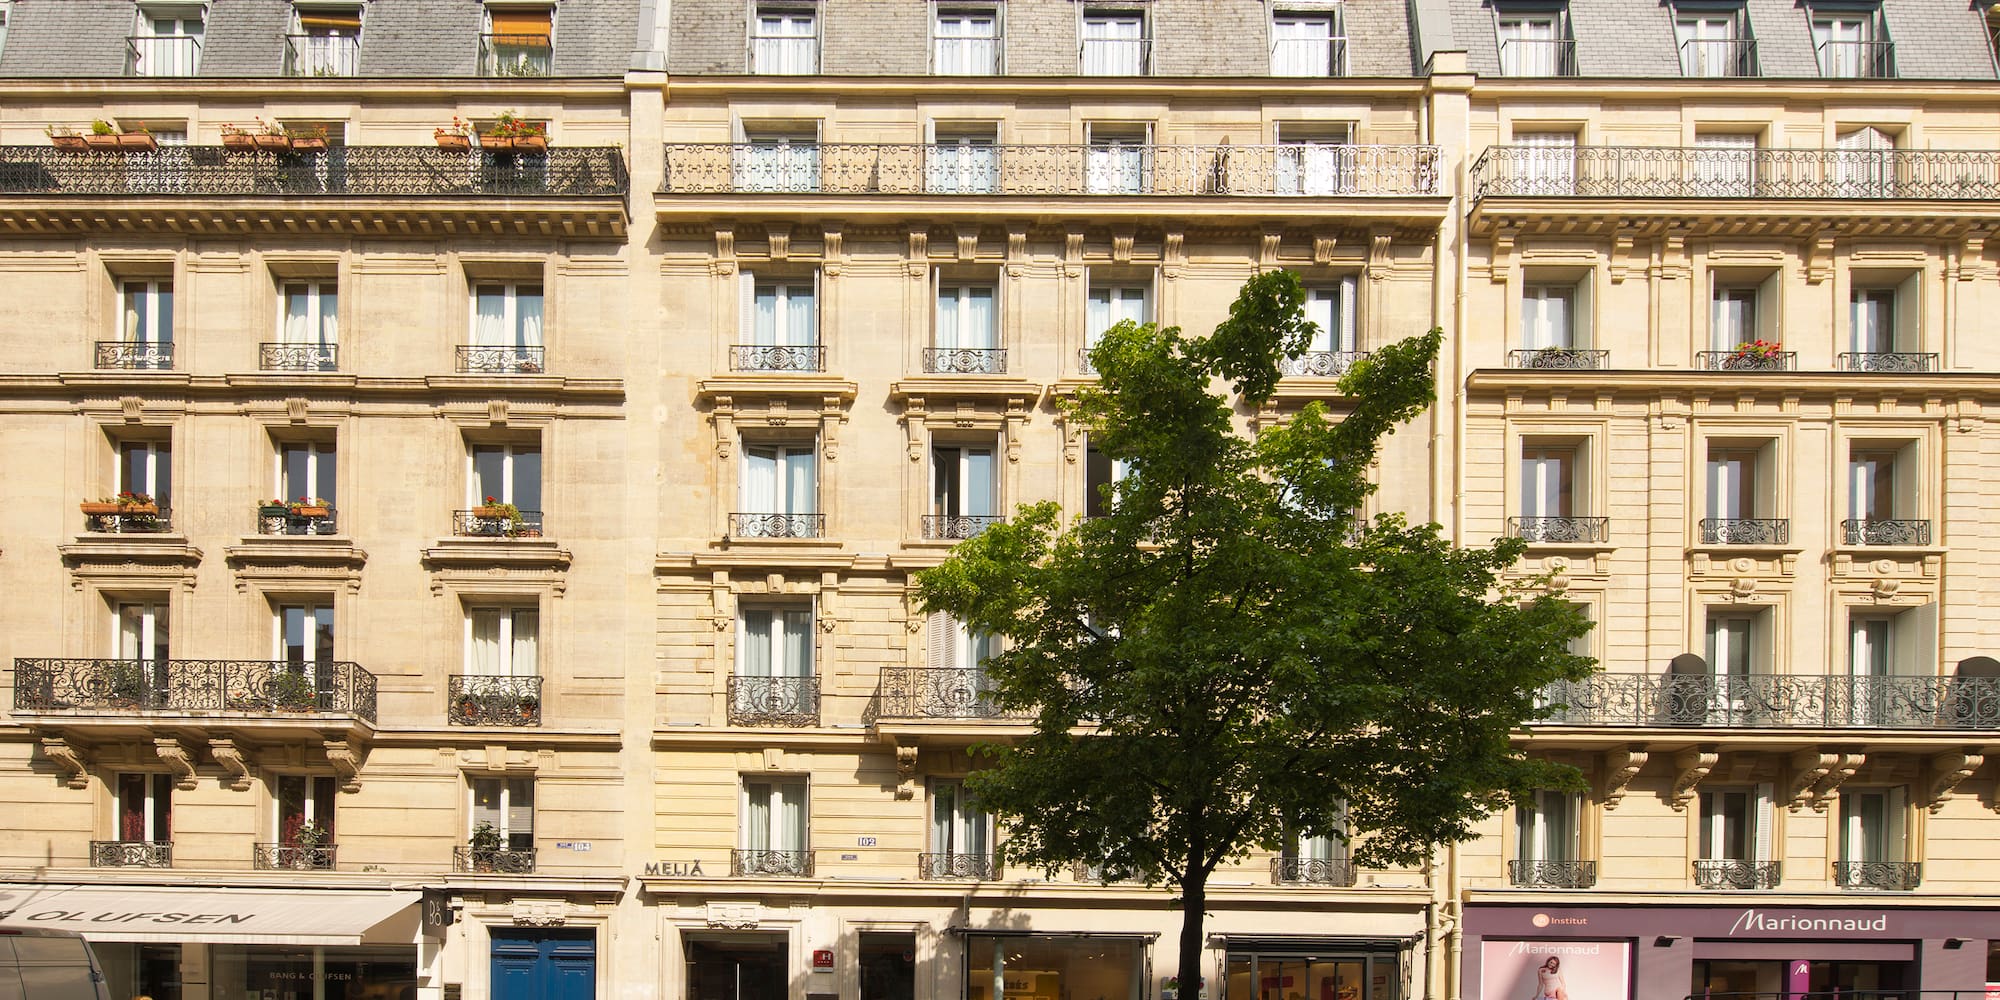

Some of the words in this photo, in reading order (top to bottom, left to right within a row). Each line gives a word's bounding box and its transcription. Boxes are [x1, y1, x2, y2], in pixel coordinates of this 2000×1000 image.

[859, 837, 876, 847] 102
[27, 910, 256, 924] OLUFSEN
[1551, 917, 1588, 925] Institut
[1729, 909, 1887, 936] Marionnaud
[1508, 941, 1600, 957] Marionnaud
